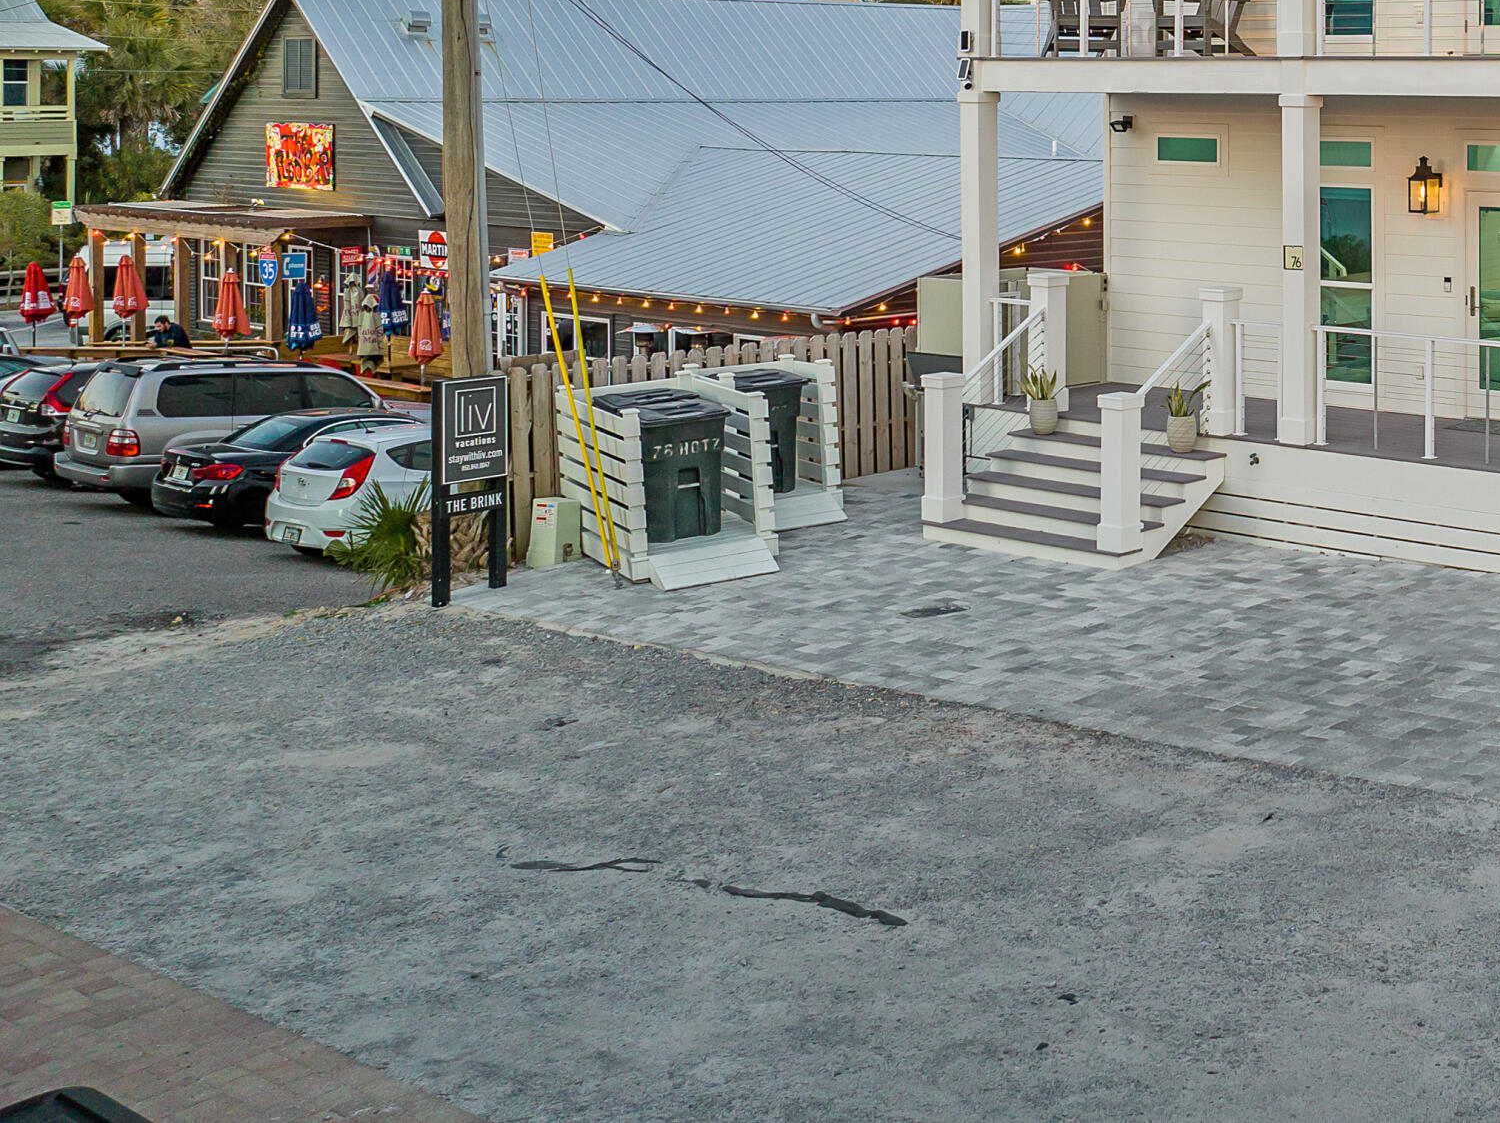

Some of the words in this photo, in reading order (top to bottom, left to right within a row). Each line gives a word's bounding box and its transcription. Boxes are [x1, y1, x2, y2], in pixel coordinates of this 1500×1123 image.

[1291, 255, 1302, 268] 76
[262, 263, 274, 279] 35
[460, 394, 492, 433] liv
[455, 437, 496, 448] vacations
[652, 443, 674, 459] 76
[679, 437, 720, 456] HOTZ
[448, 449, 503, 464] staywithliv.com
[446, 498, 467, 514] THE
[470, 492, 502, 510] BRINK
